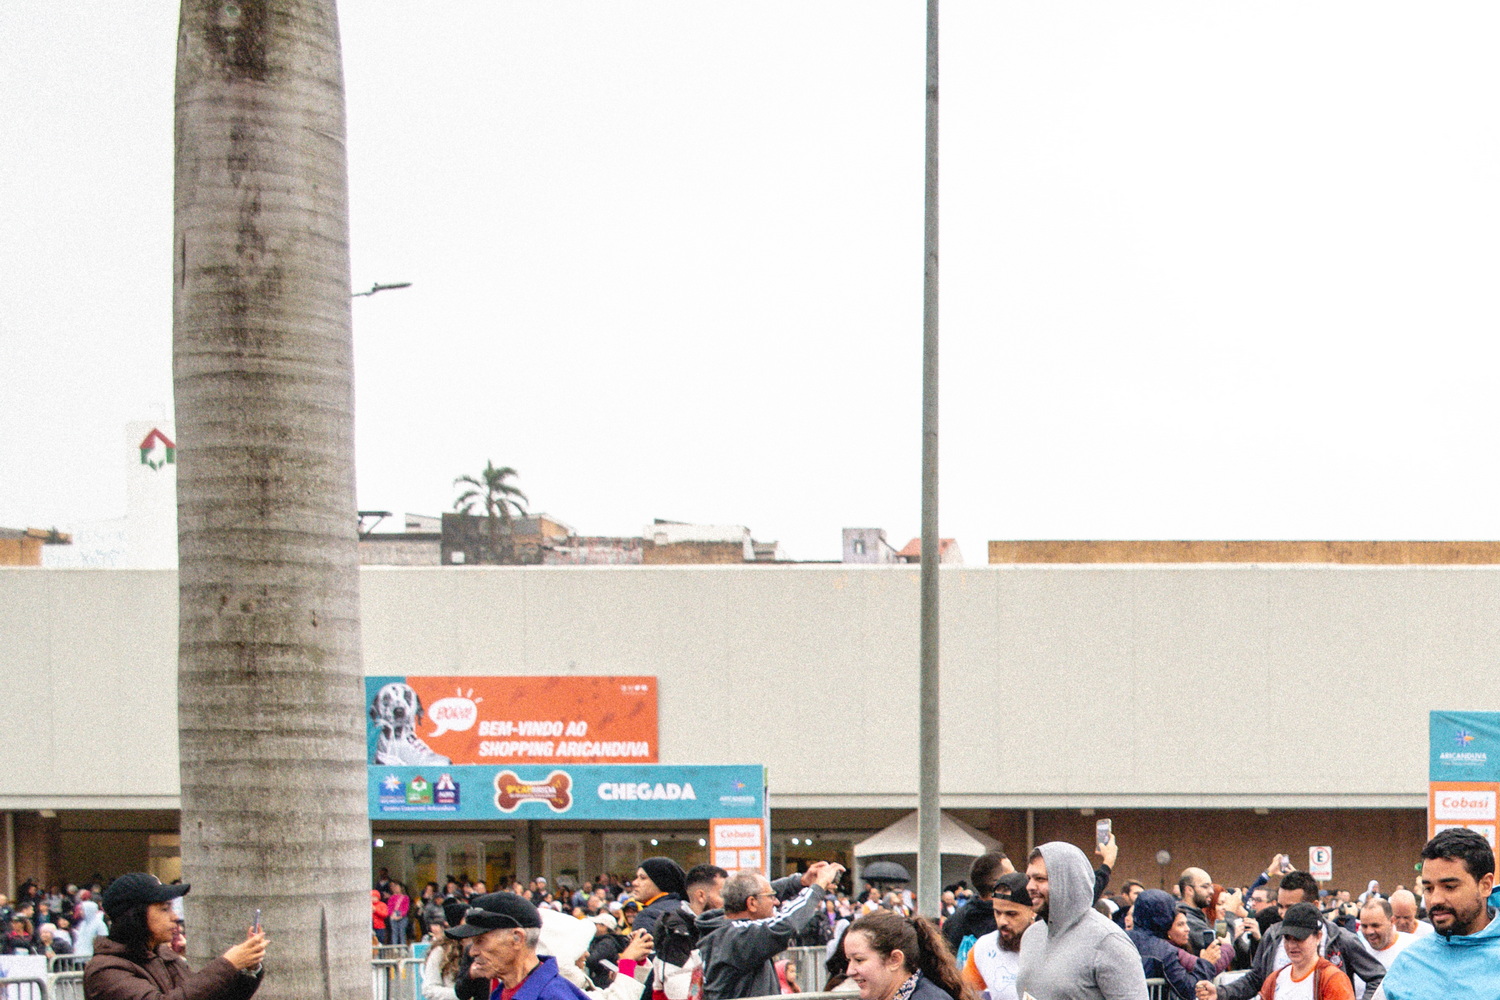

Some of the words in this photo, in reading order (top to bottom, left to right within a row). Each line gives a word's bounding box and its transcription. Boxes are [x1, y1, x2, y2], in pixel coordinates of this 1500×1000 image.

[478, 720, 564, 737] BEM-VINDO
[565, 720, 588, 737] AO
[478, 741, 554, 757] SHOPPING
[555, 741, 649, 758] ARICANDUVA
[1440, 752, 1487, 761] ARICANDUVA
[597, 782, 697, 801] CHEGADA
[1442, 796, 1489, 810] Cobasi
[1317, 851, 1323, 862] E
